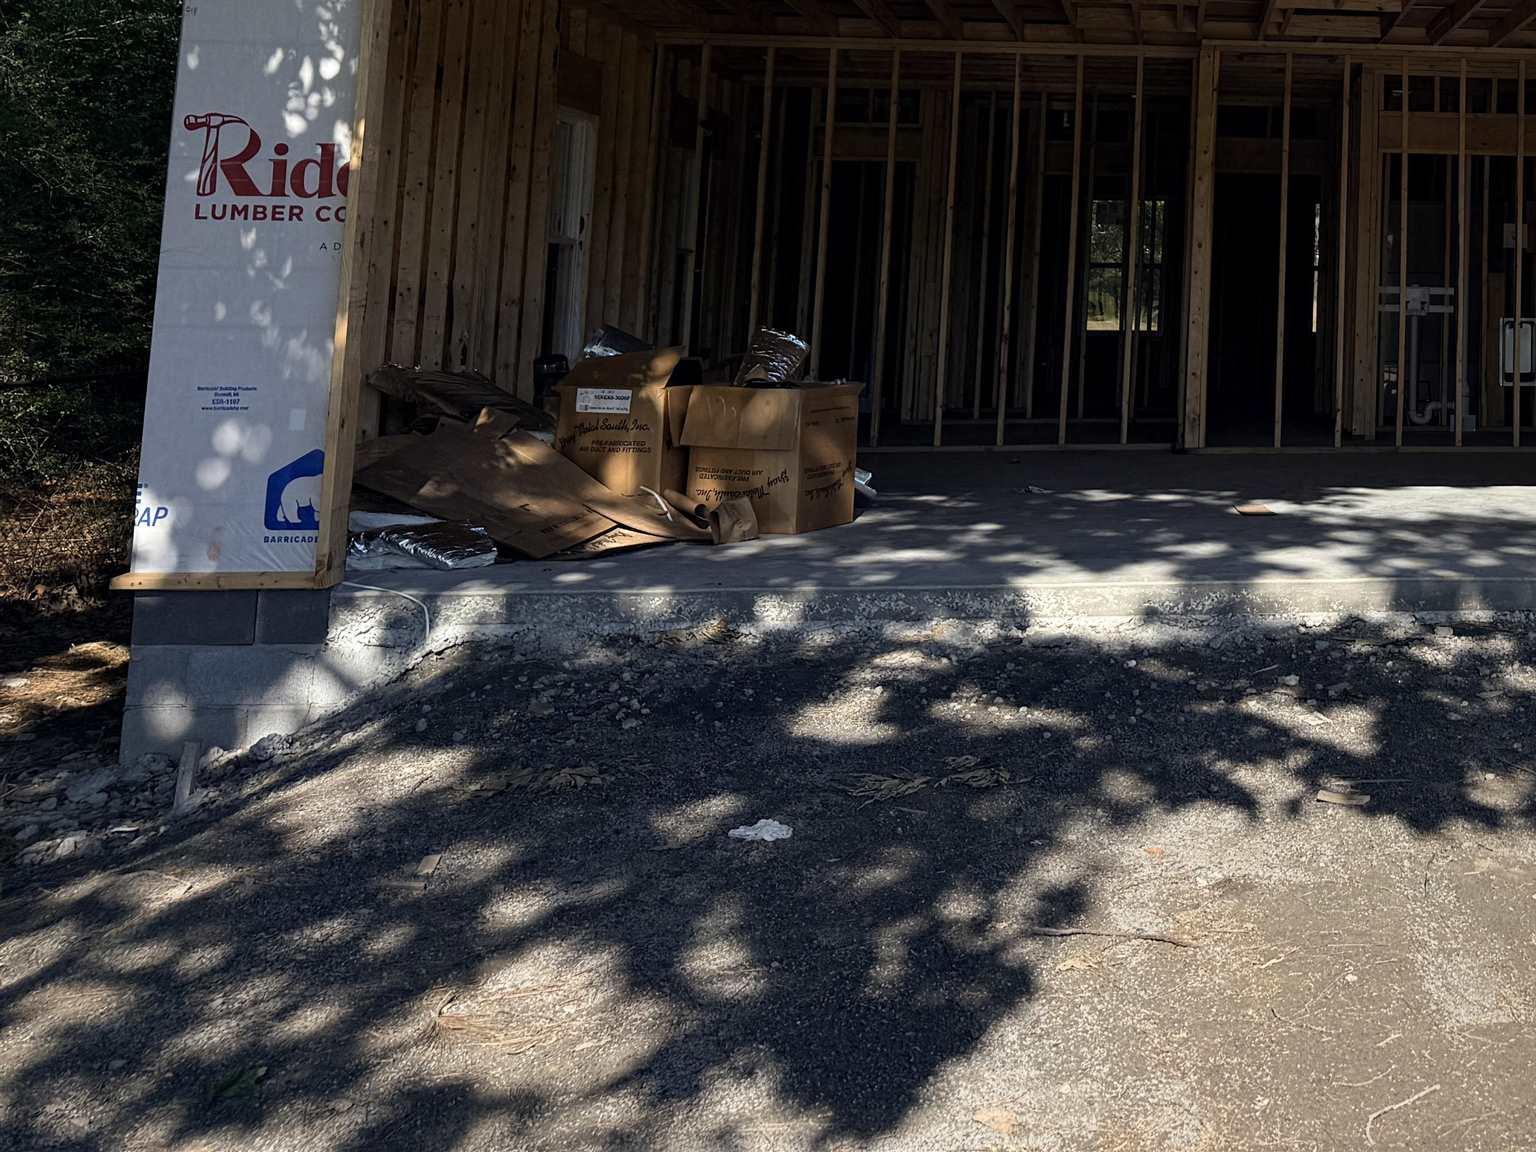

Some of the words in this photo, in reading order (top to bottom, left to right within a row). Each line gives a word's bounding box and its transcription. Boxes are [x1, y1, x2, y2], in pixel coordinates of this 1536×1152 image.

[195, 204, 304, 222] LUMBER
[135, 506, 168, 527] AP
[264, 535, 318, 544] BARRICAD
